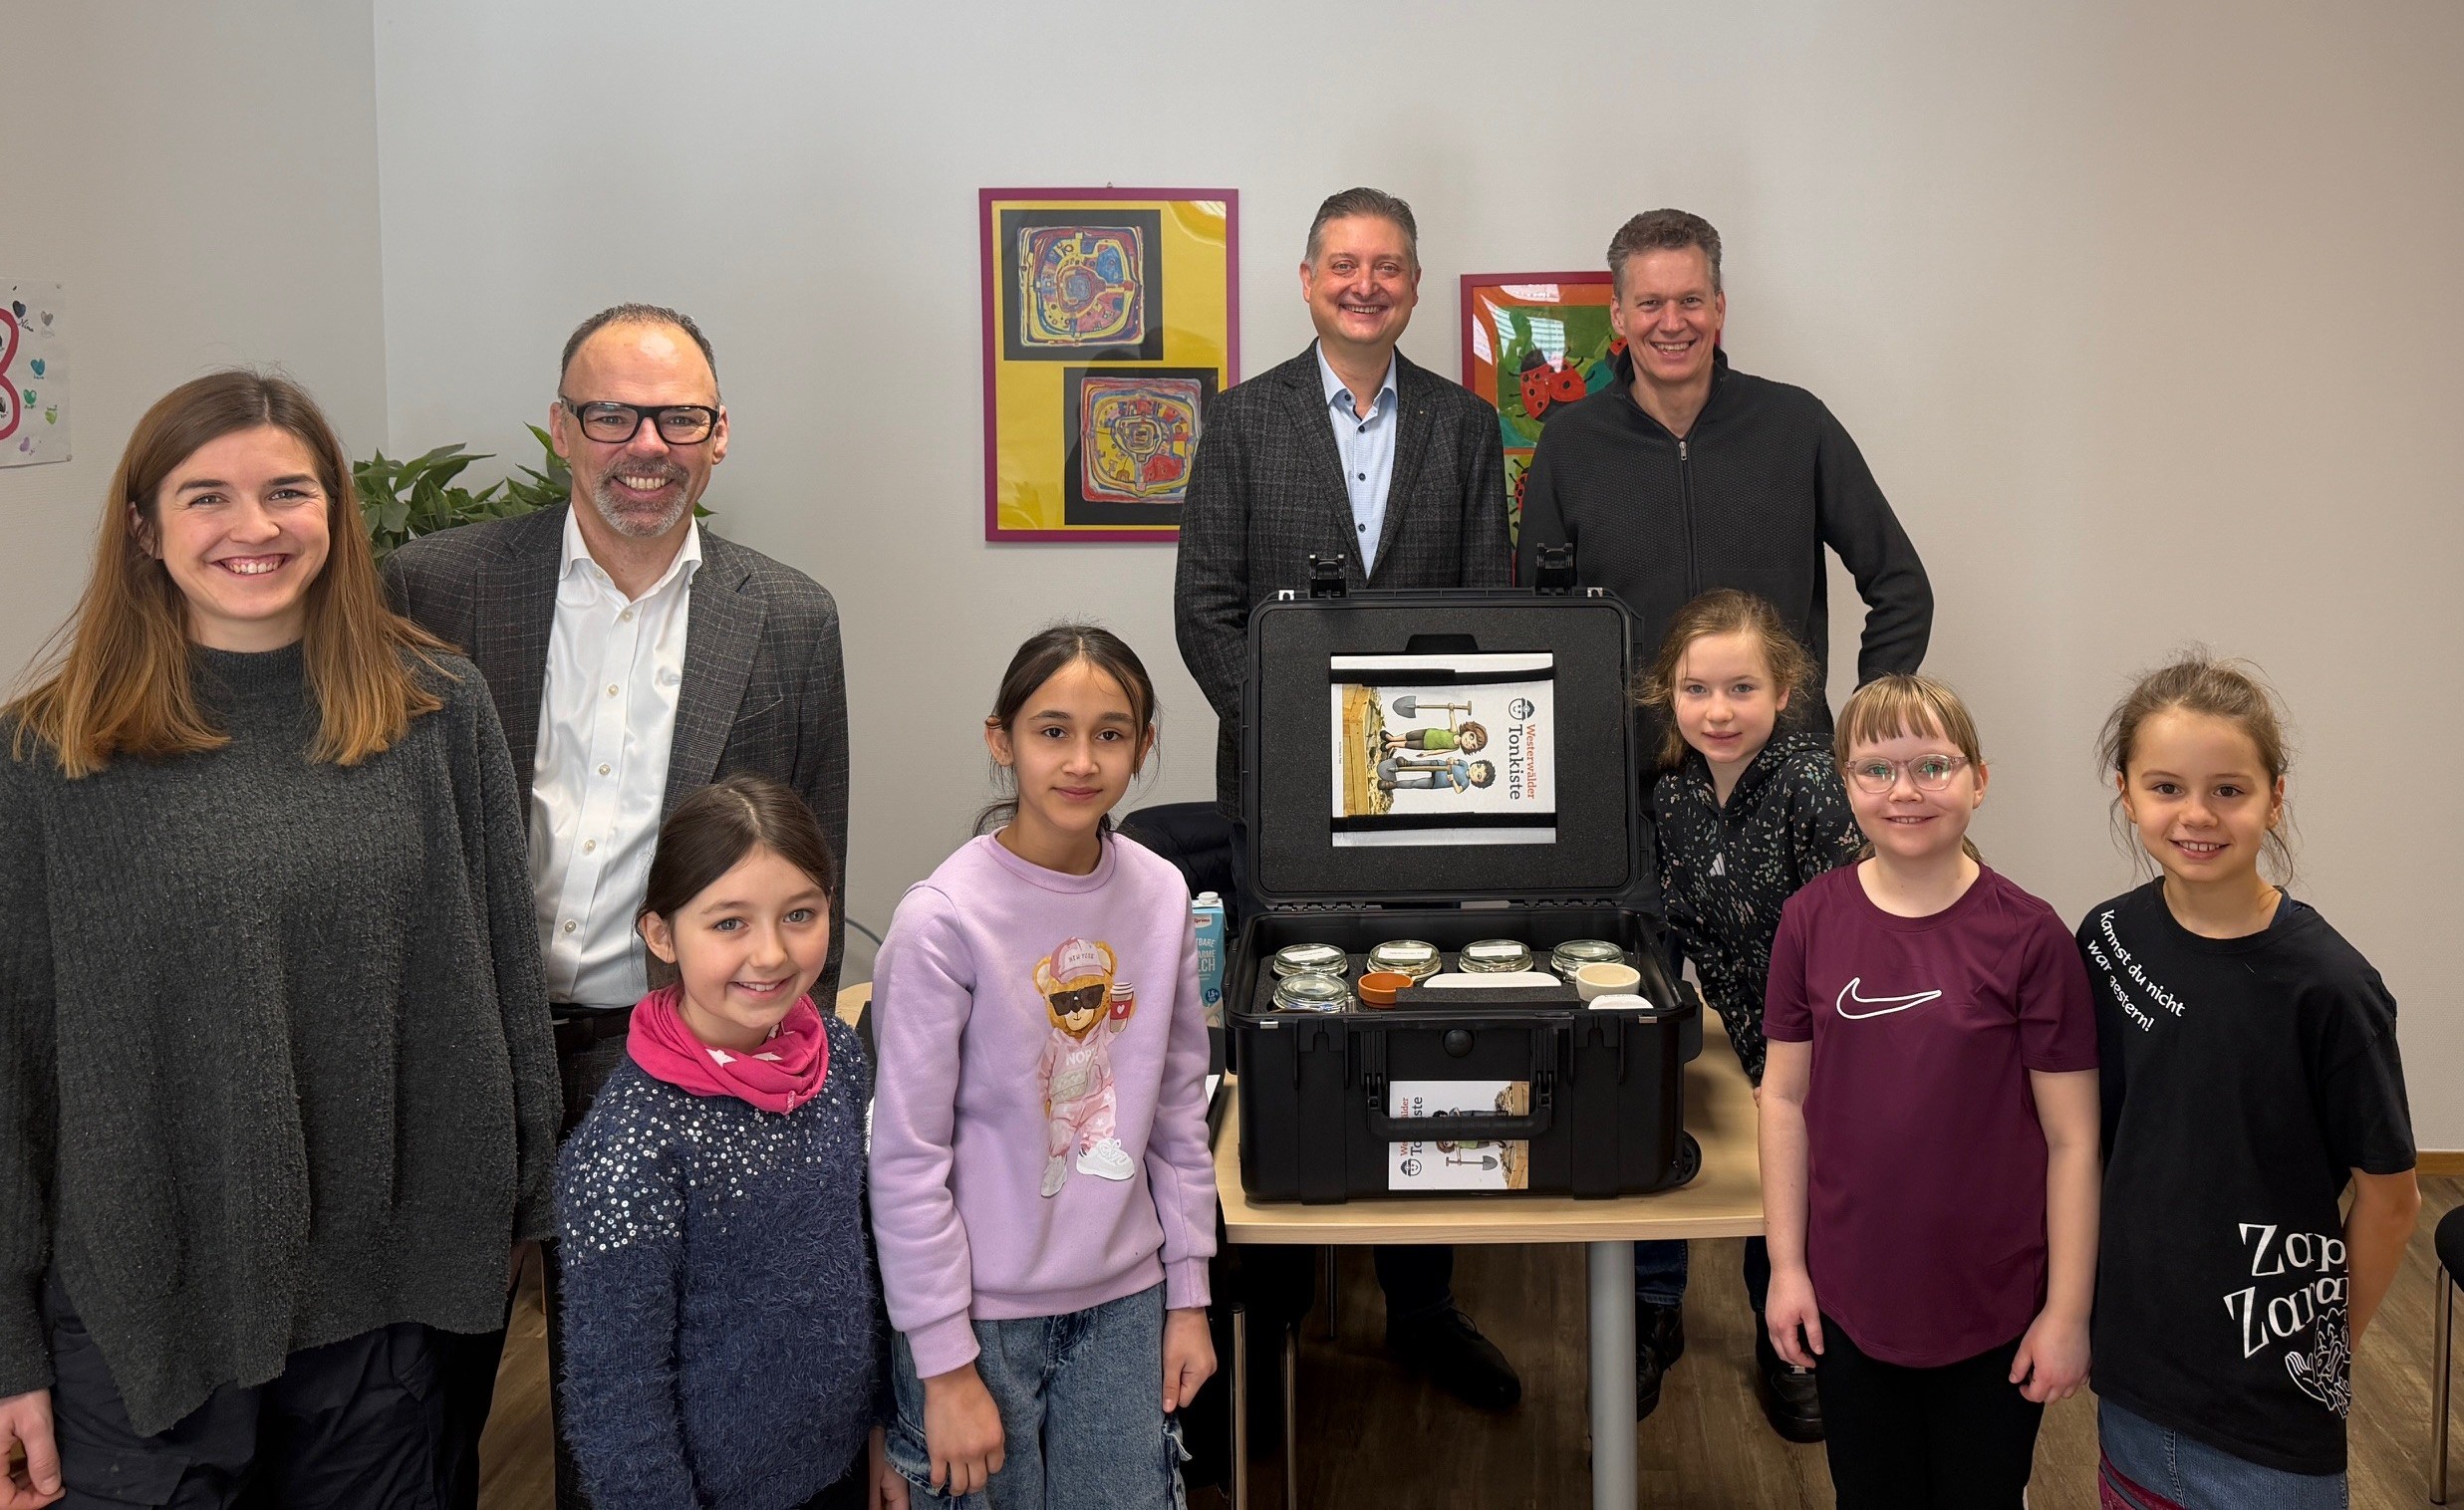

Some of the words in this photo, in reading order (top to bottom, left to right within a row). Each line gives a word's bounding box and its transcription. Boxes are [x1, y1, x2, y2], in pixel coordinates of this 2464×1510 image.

[1508, 723, 1524, 800] Tonkiste
[1525, 723, 1537, 800] Westerwälder
[2087, 939, 2112, 971] war
[2100, 908, 2132, 966] Kannst
[2128, 963, 2147, 986] du
[2145, 981, 2186, 1017] nicht
[2238, 1222, 2349, 1277] Zap
